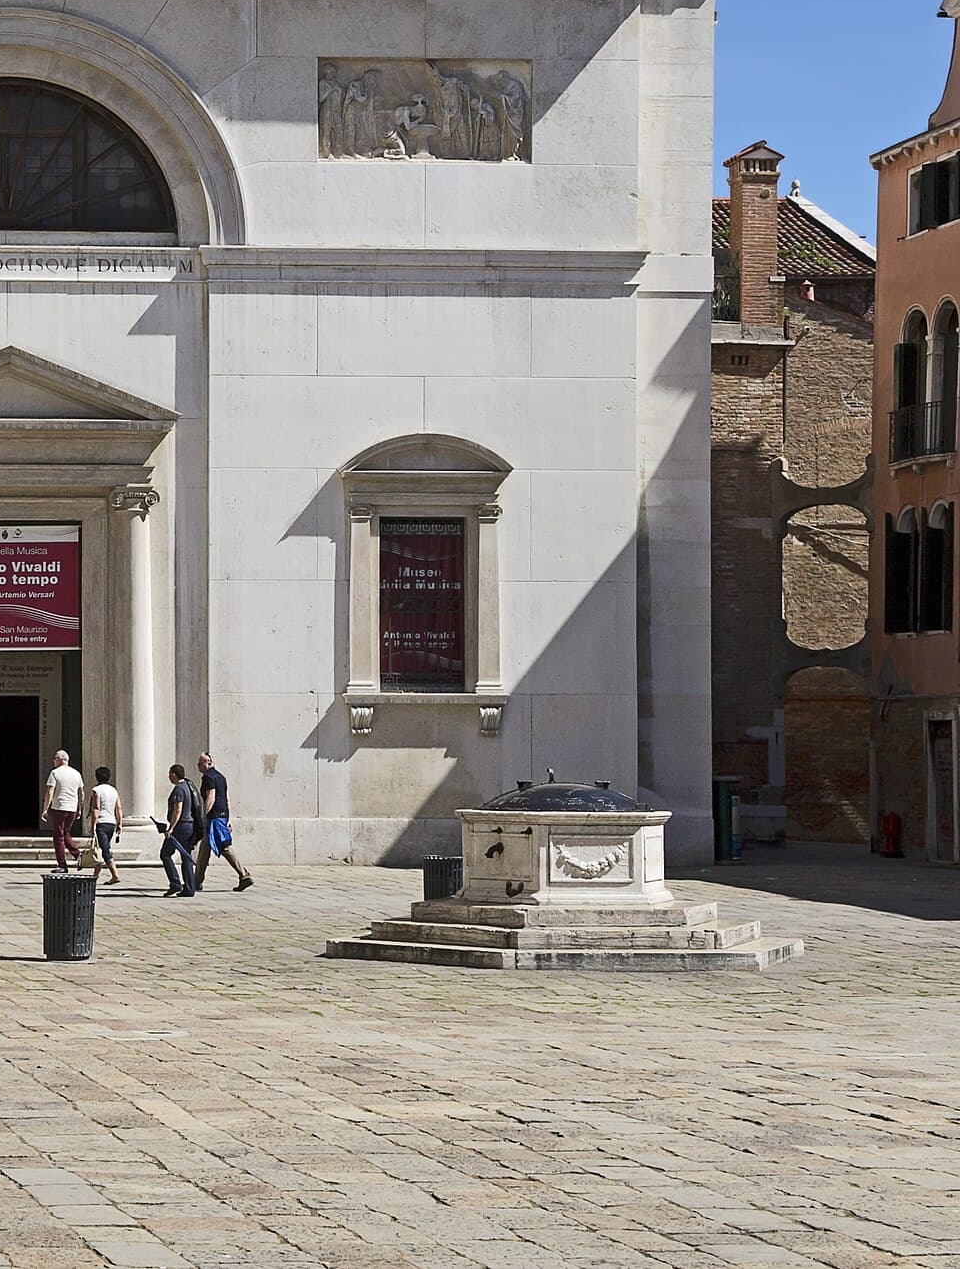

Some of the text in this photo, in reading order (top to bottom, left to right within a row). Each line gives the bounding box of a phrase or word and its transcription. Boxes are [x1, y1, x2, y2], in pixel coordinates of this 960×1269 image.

[16, 546, 48, 555] Musica
[11, 561, 61, 572] Vivaldi
[12, 574, 58, 587] tempo
[0, 626, 14, 634] San
[16, 625, 48, 634] Maurizio
[30, 636, 48, 644] entry
